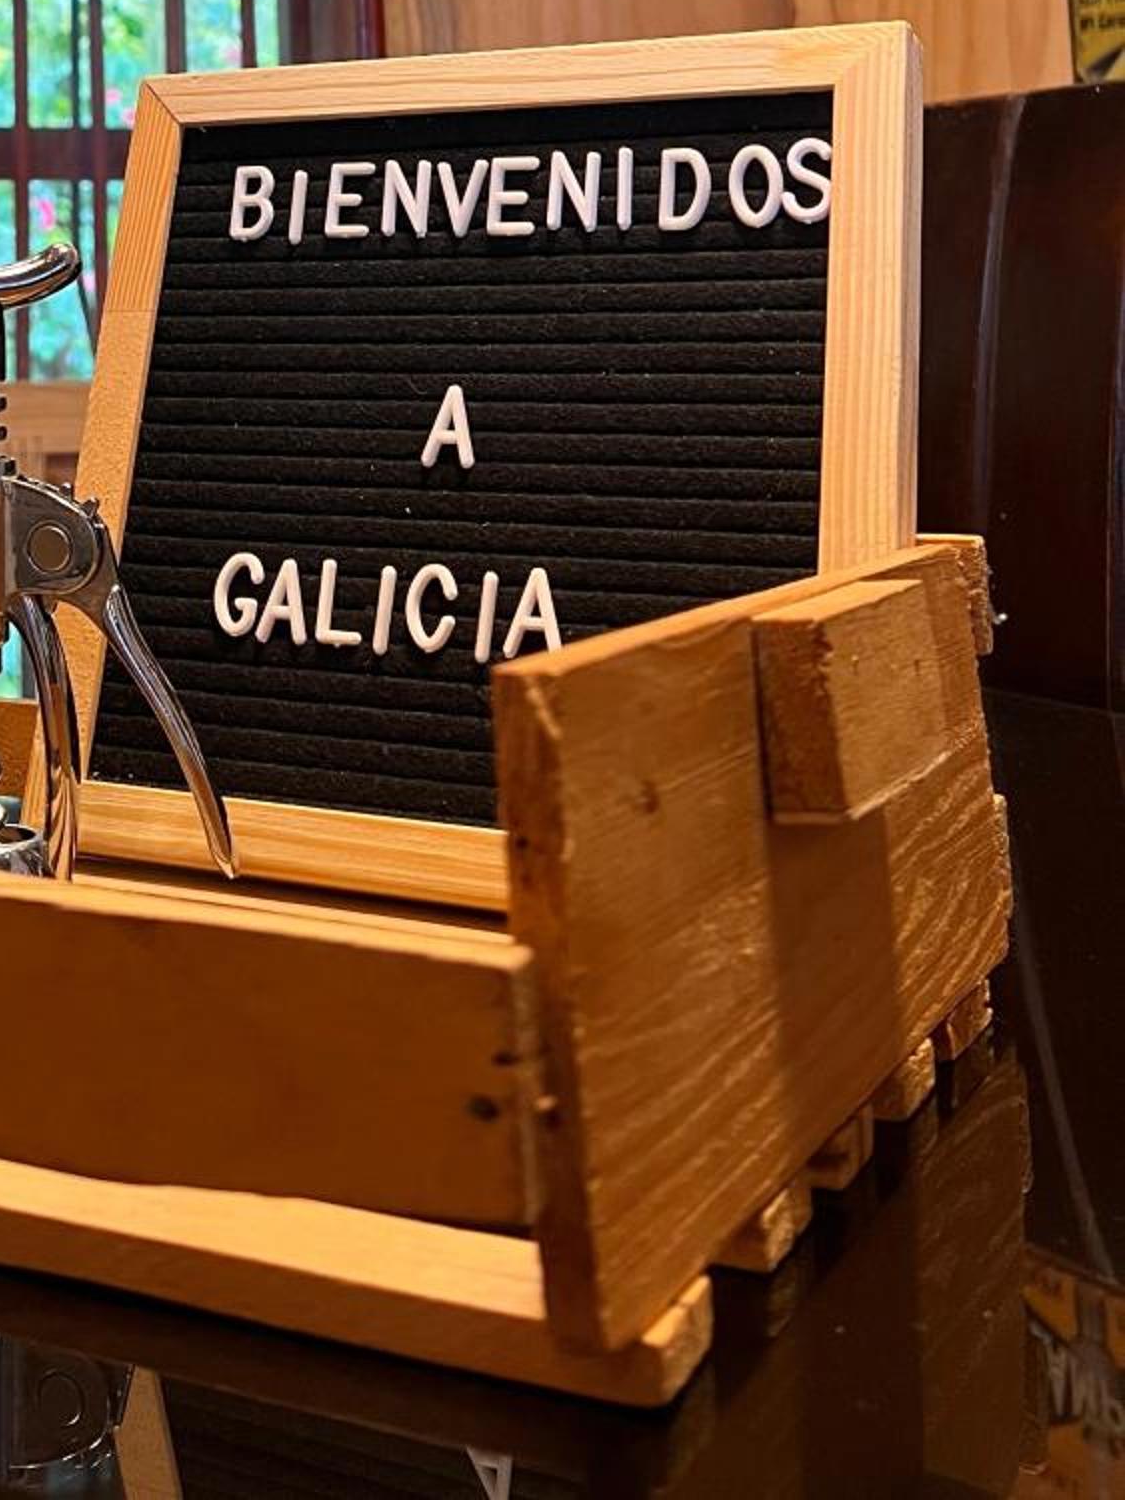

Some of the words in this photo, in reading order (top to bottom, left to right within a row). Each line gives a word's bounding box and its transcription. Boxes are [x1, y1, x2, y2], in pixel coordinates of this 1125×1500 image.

[228, 137, 832, 246] BIENVENIDOS
[420, 383, 475, 470] A
[213, 551, 563, 664] GALICIA
